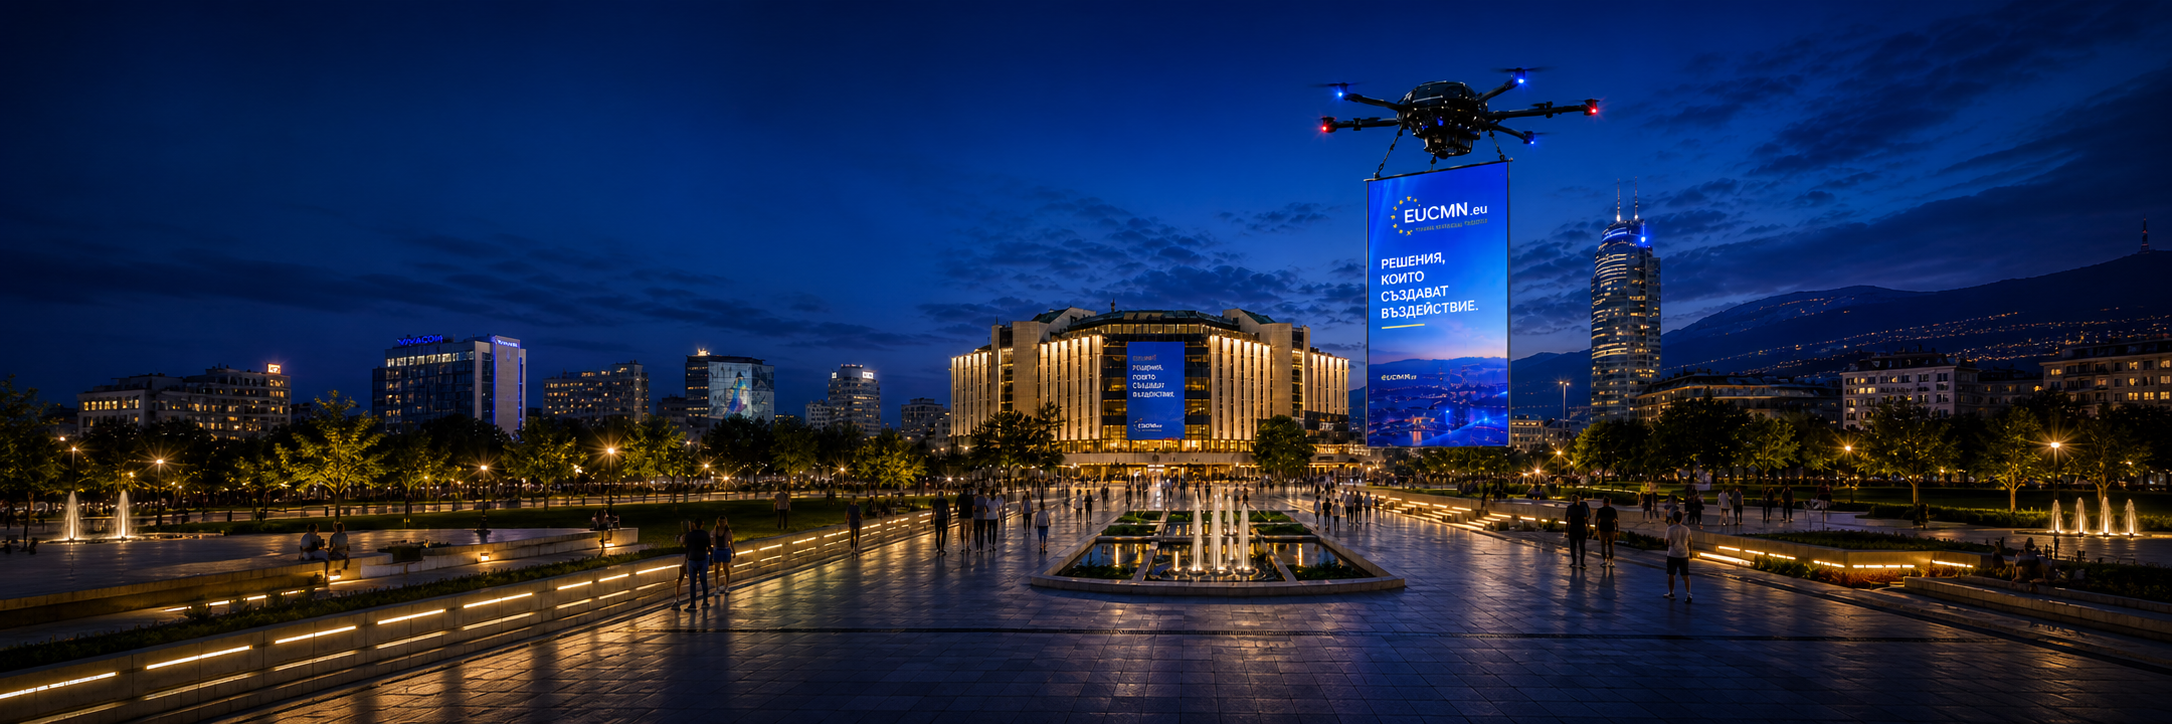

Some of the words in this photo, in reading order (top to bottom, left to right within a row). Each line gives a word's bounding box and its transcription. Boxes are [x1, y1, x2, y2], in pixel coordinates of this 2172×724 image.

[1381, 252, 1445, 269] РЕШЕНИЯ,
[1381, 270, 1425, 285] КОИТО
[1381, 285, 1449, 302] СЪЗДАВАТ
[1381, 300, 1479, 319] ВЪЗДЕЙСТВИЕ.
